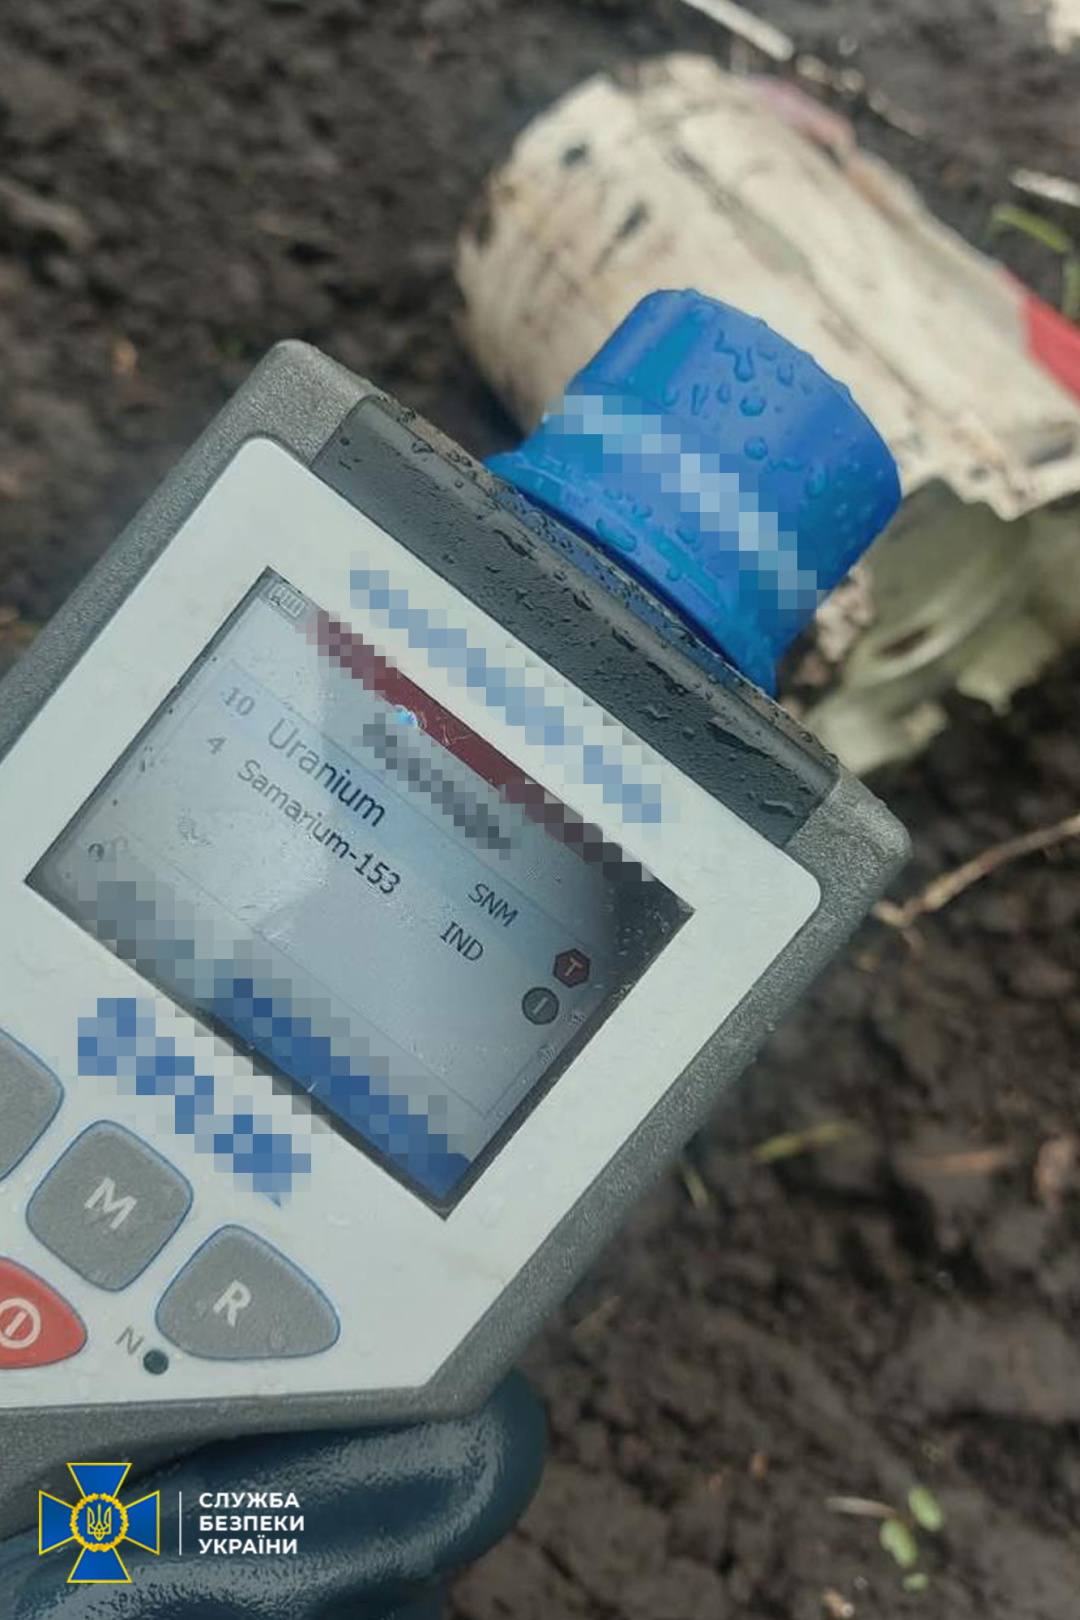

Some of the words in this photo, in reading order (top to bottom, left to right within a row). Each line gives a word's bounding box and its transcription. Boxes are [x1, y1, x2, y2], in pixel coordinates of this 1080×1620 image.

[222, 687, 254, 717] 10
[266, 717, 387, 828] Uranium
[468, 882, 519, 929] SNM
[207, 736, 227, 755] 4
[236, 758, 402, 896] Samarium-153
[440, 922, 484, 963] IND
[84, 1178, 138, 1230] M
[213, 1279, 252, 1327] R
[115, 1326, 143, 1355] N
